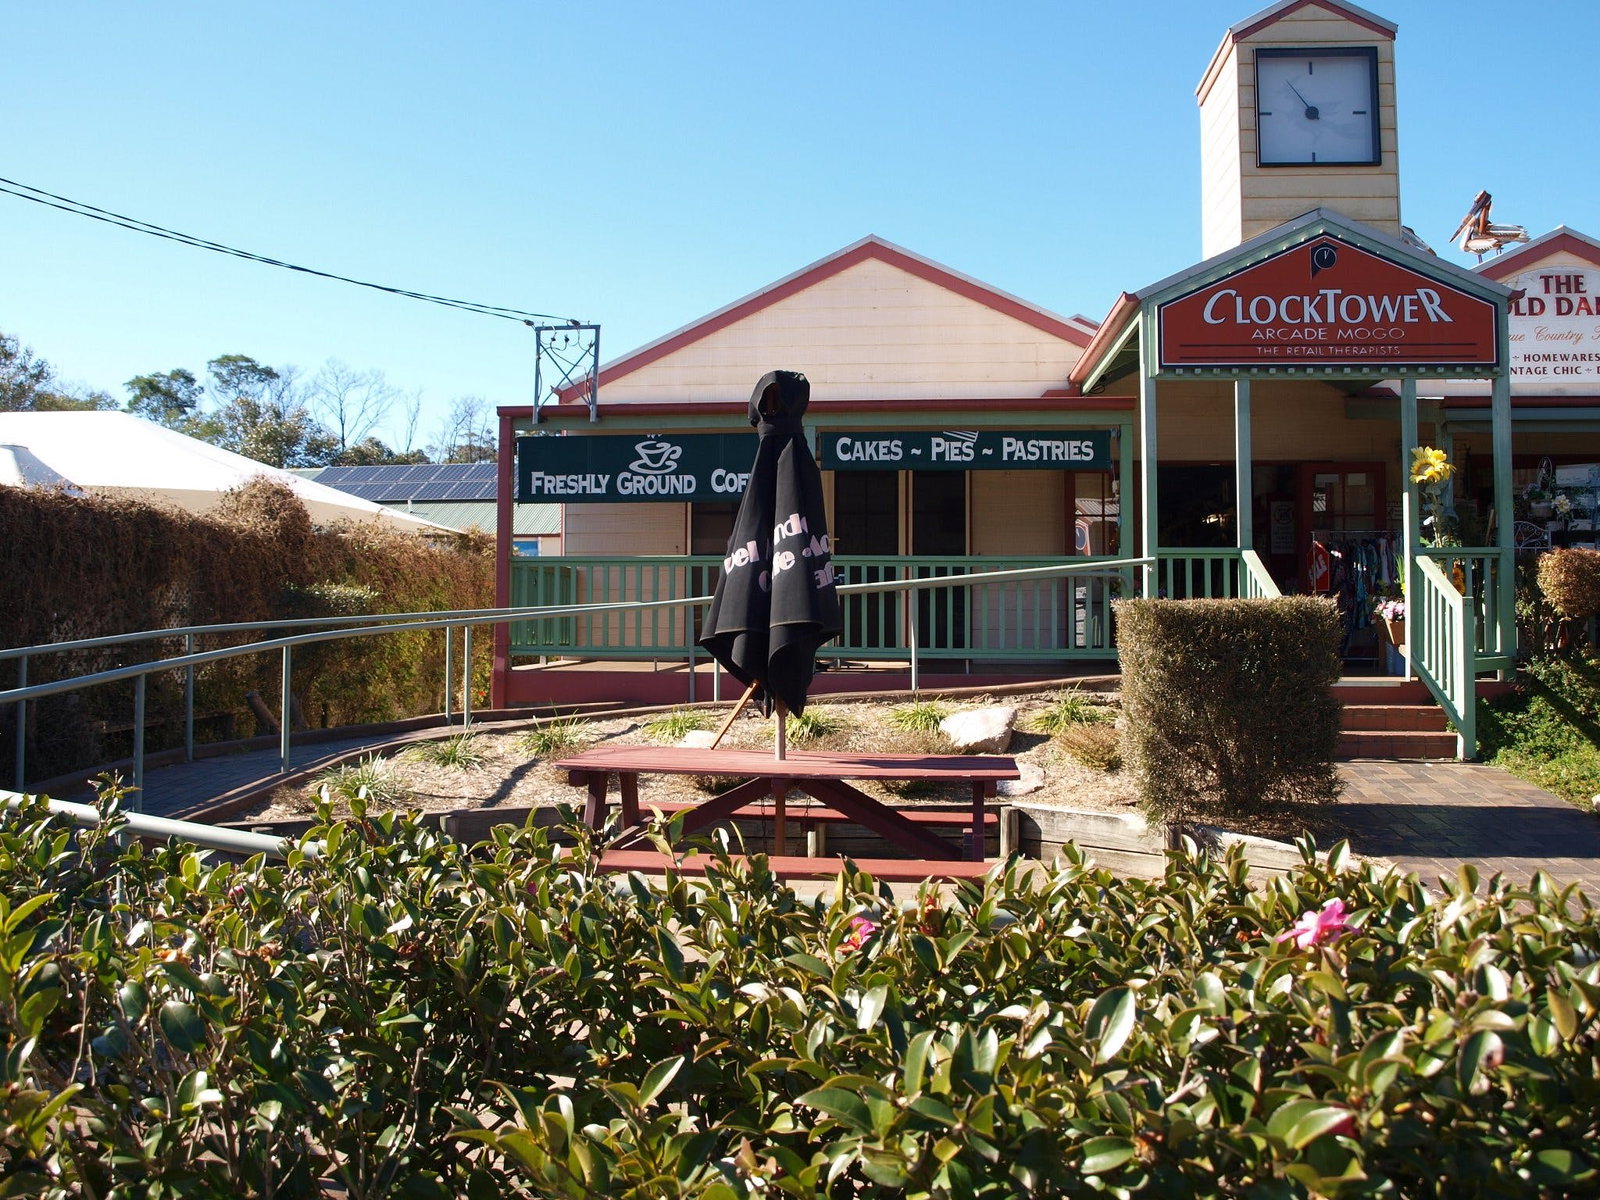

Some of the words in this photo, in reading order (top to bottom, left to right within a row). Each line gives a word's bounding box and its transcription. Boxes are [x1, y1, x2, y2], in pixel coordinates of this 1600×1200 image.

[1540, 275, 1587, 294] THE
[1508, 297, 1546, 316] LD
[1251, 328, 1328, 340] ARCADE
[1337, 328, 1405, 340] MOGO
[1534, 326, 1583, 345] Country
[1256, 346, 1279, 355] THE
[1286, 346, 1323, 356] RETAIL
[1328, 346, 1401, 355] THERAPISTS
[1523, 353, 1600, 362] HOMEWARES
[1510, 366, 1548, 375] NTAGE
[1553, 366, 1582, 375] CHIC
[836, 437, 903, 461] CAKES
[931, 437, 974, 462] PIES
[1002, 437, 1094, 461] PASTRIES
[531, 471, 610, 495] FRESHLY
[616, 471, 696, 495] GROUND
[710, 468, 752, 493] COF
